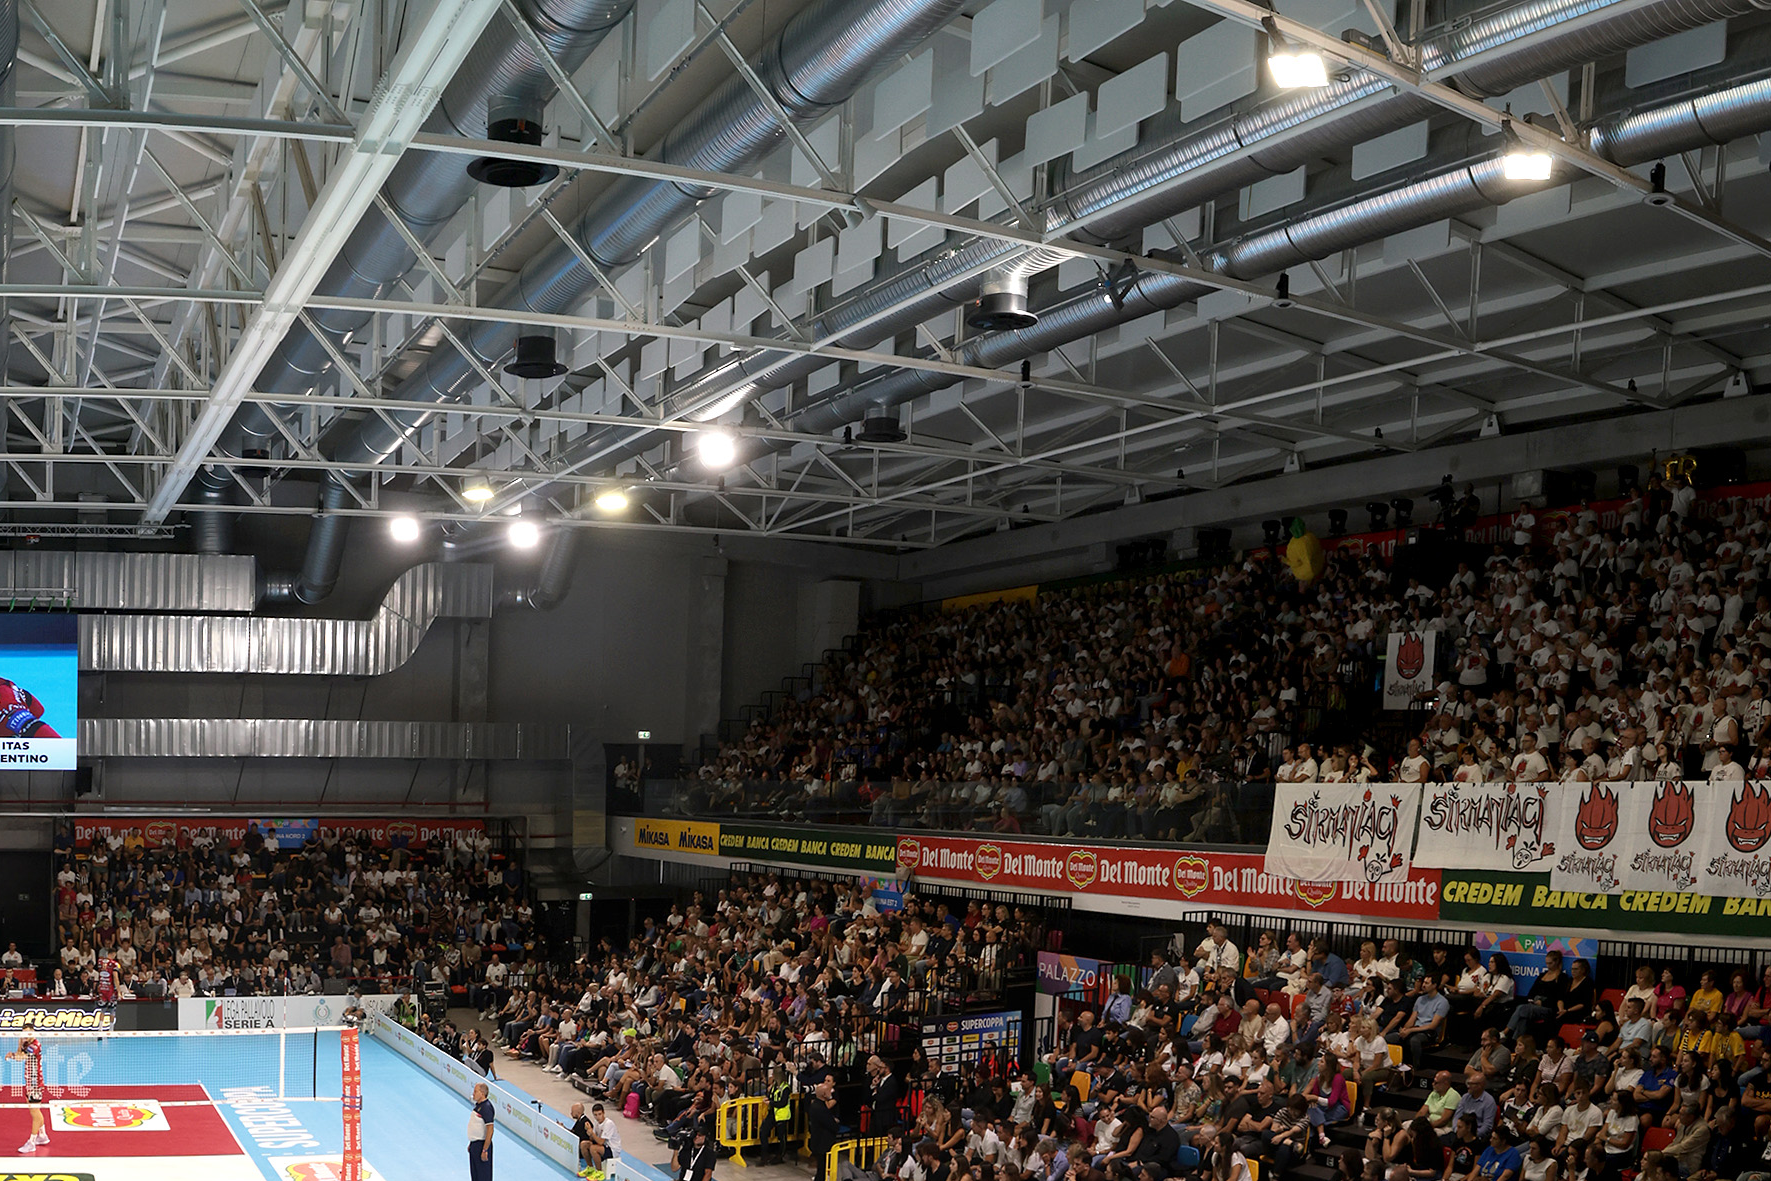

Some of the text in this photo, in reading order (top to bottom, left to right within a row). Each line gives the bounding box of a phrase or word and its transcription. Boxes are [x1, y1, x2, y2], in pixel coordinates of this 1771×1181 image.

[2, 741, 30, 750] ITAS
[720, 834, 769, 850] CREDEM BANCA
[771, 836, 827, 855] CREDEM BANCA
[830, 842, 895, 862] CREDEM BANCA
[922, 847, 974, 870] Del Monte
[1004, 853, 1063, 878] Del Monte
[1100, 859, 1170, 887] Del Monte
[1213, 866, 1294, 896] Del Monte
[1341, 880, 1437, 906] Del Monte
[1443, 880, 1608, 911] CREDEM BANCA
[1619, 891, 1713, 915] CREDEM
[1038, 961, 1096, 987] PALAZZO
[224, 1000, 275, 1020] LEGA PALLAVOLO
[225, 1019, 275, 1029] SERIE A
[961, 1016, 1004, 1031] SUPERCOPPA
